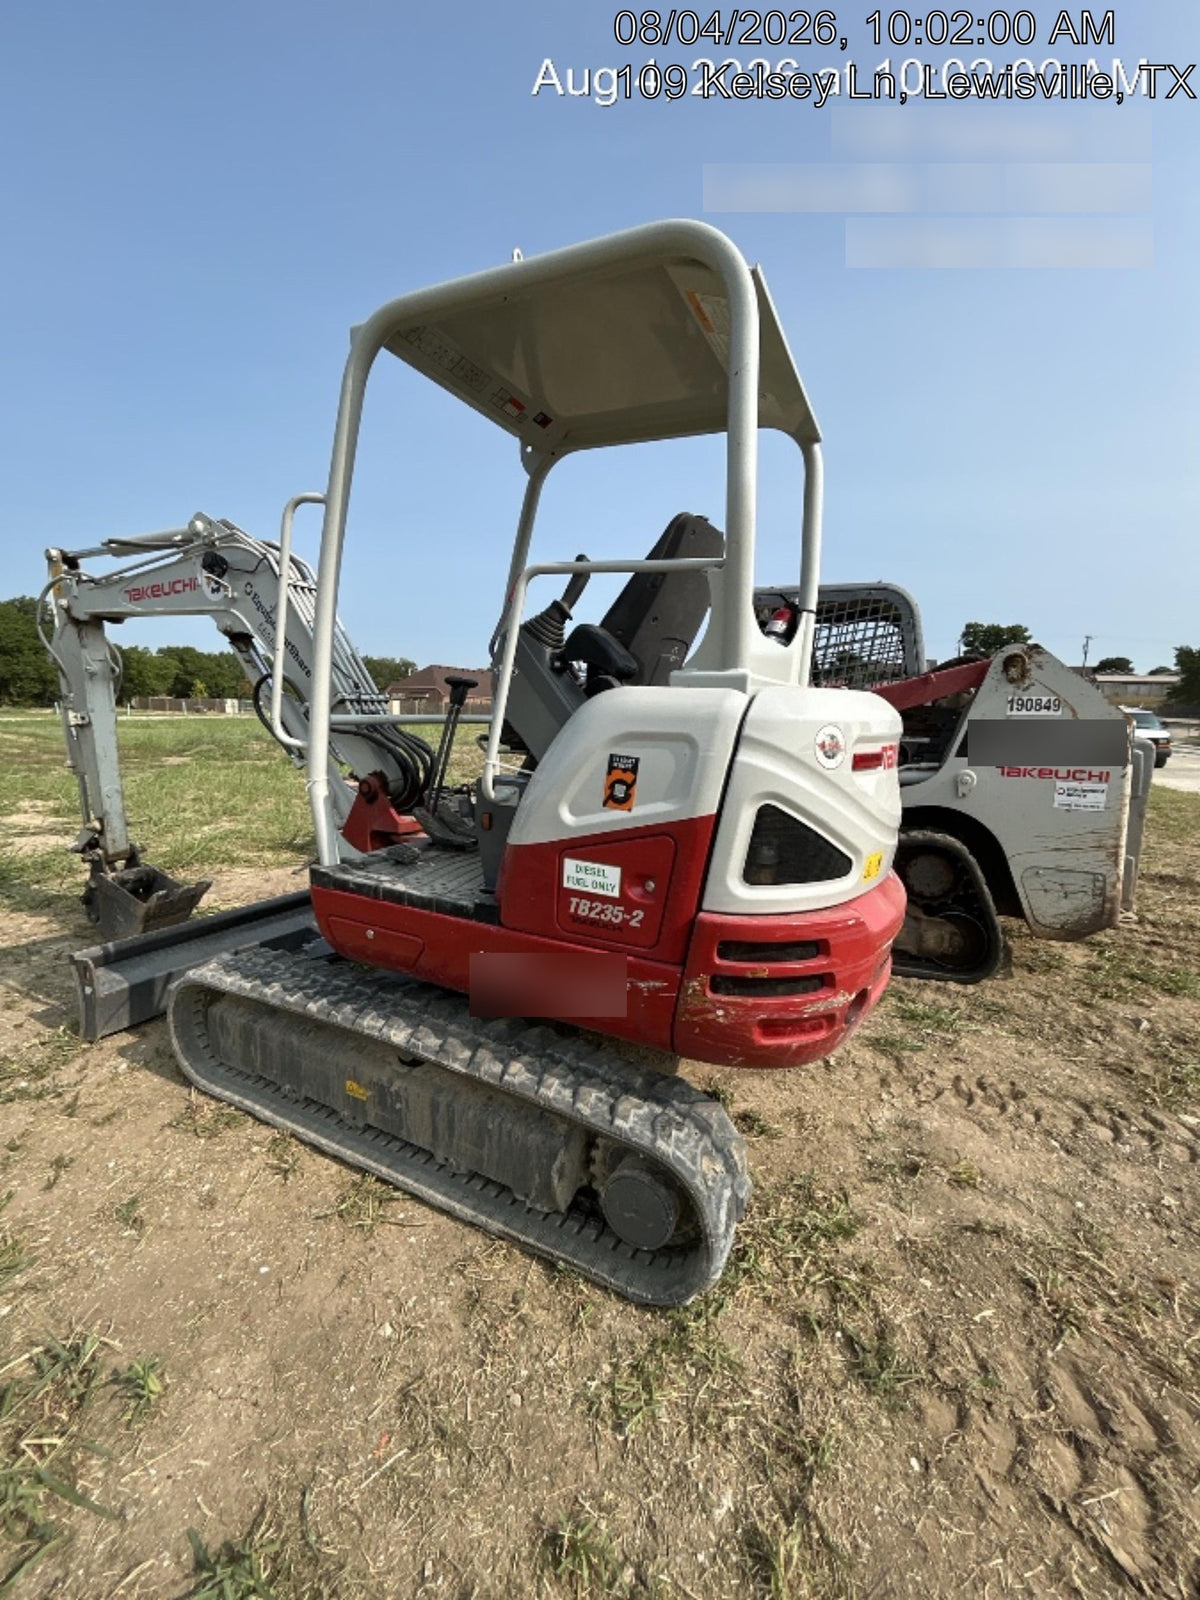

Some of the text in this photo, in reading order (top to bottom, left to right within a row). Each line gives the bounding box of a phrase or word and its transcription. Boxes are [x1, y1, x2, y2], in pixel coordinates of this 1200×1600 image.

[1007, 697, 1062, 713] 190849
[575, 863, 609, 879] DIESEL
[566, 875, 616, 894] FUEL ONLY
[569, 897, 645, 928] TB235-2
